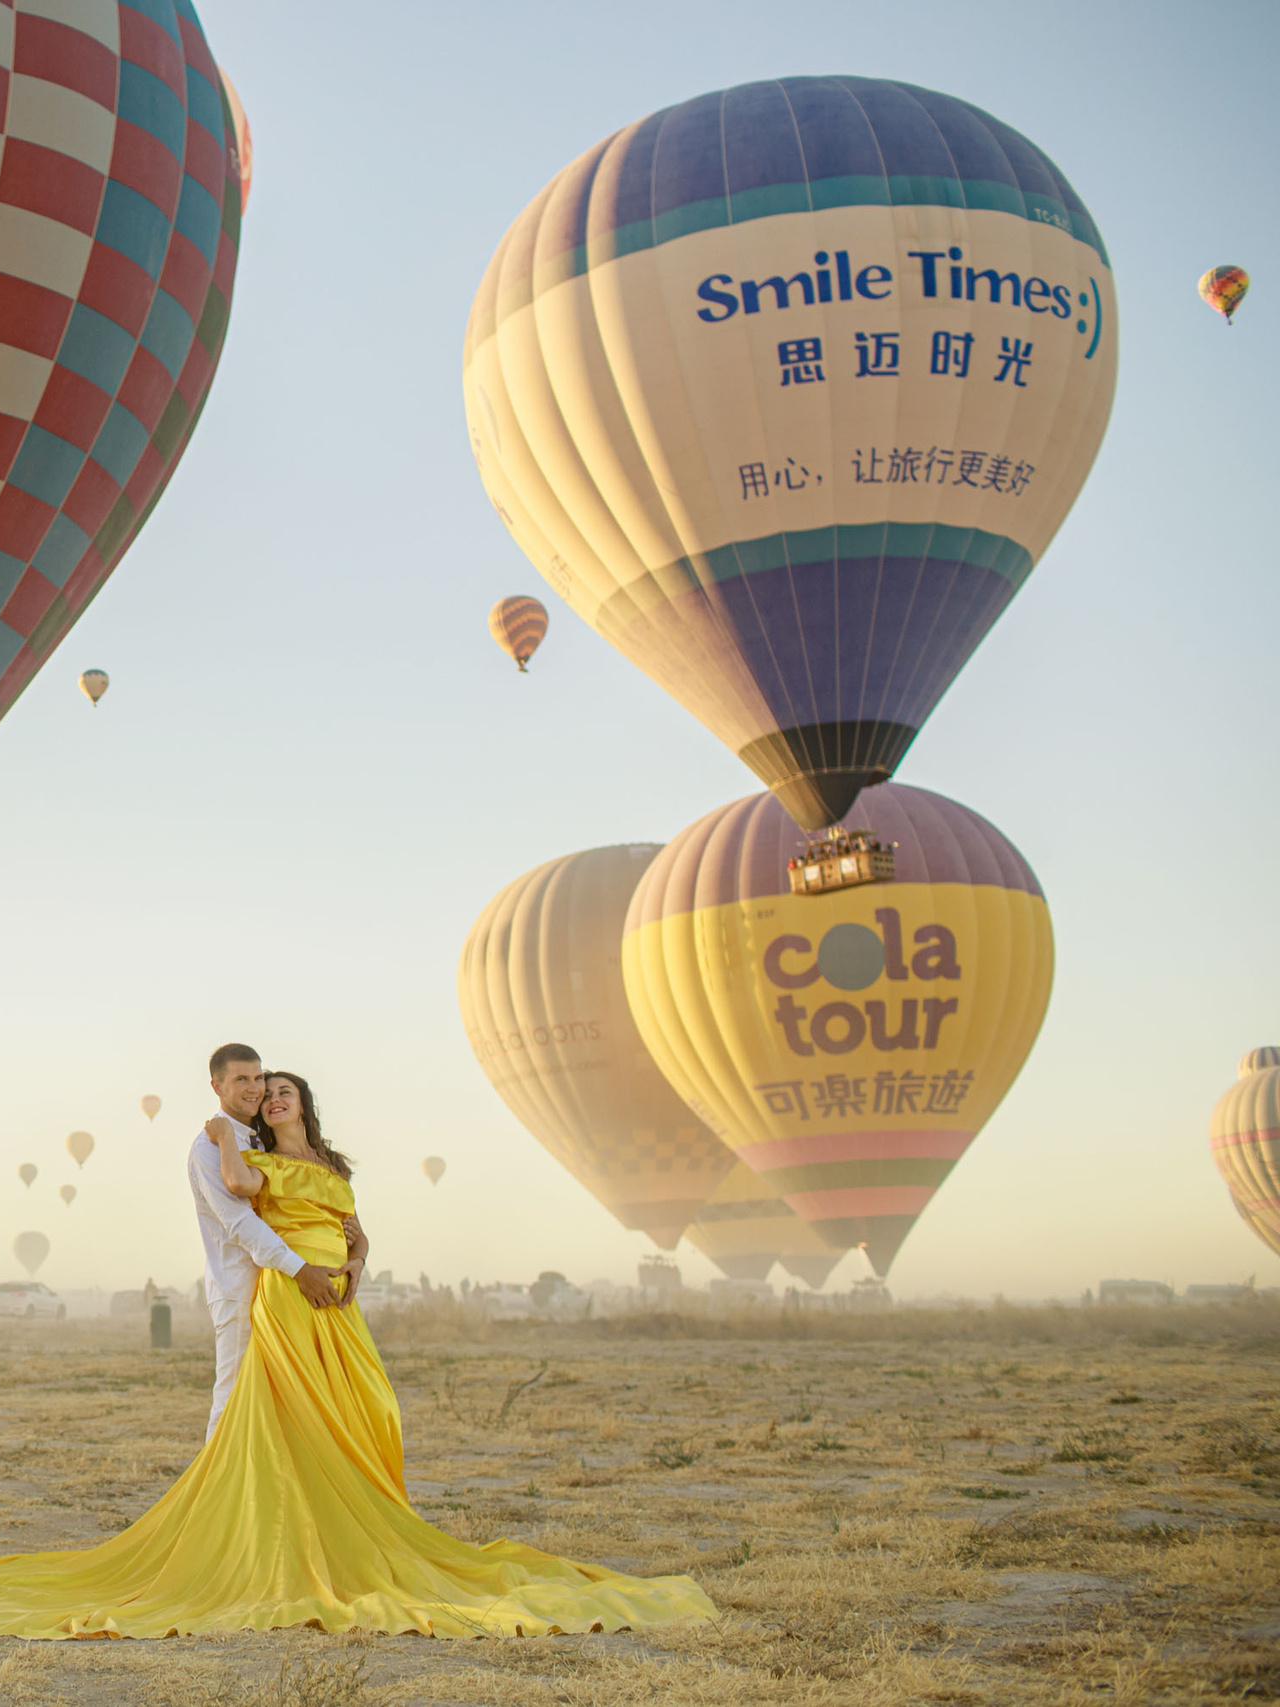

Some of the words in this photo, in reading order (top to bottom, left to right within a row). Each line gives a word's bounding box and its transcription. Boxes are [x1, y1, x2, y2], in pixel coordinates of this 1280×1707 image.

[697, 250, 892, 323] Smile
[777, 330, 1034, 388] 思迈时光
[763, 906, 962, 990] cola
[774, 994, 959, 1058] tour
